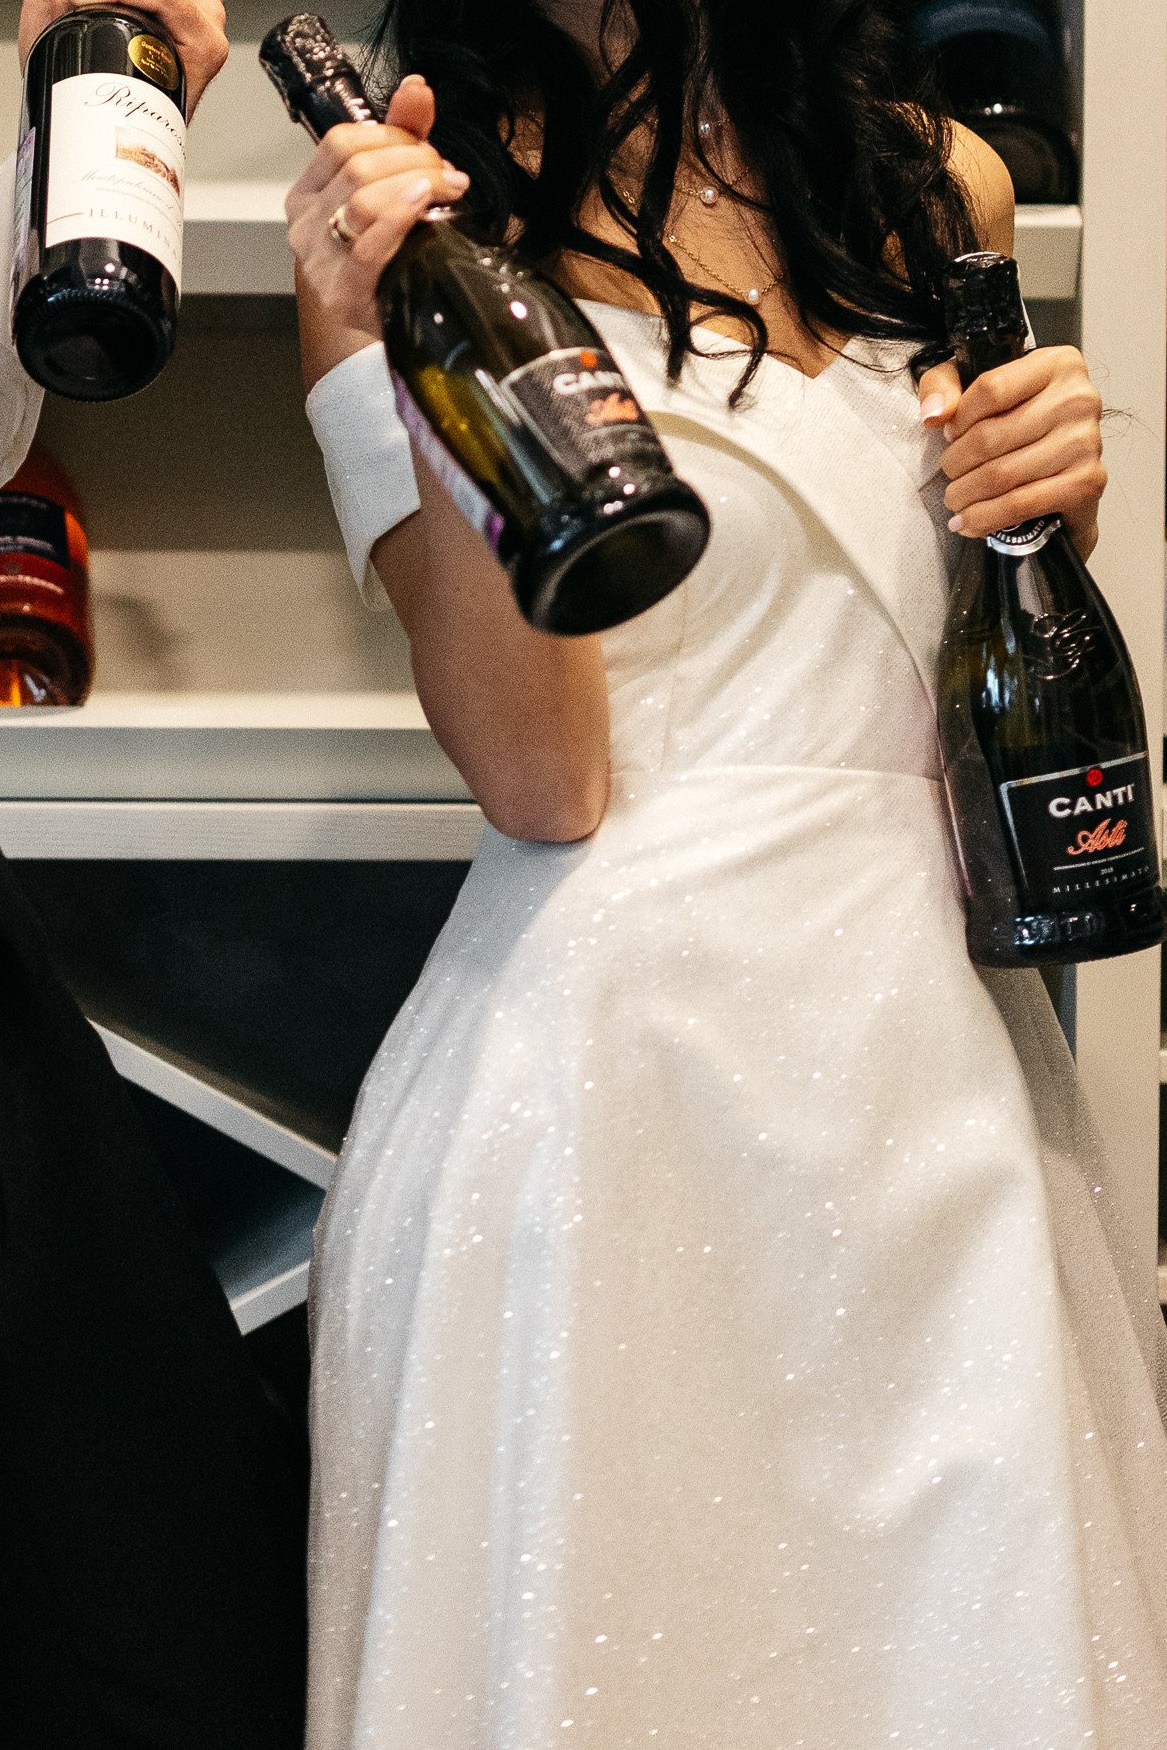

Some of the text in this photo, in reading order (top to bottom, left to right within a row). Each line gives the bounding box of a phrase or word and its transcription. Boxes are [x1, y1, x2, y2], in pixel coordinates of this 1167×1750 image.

[994, 520, 1045, 544] ILLESIMATO
[1048, 783, 1134, 818] CANTI
[1067, 818, 1129, 855] Asti
[1052, 866, 1149, 893] MILLESIMATO
